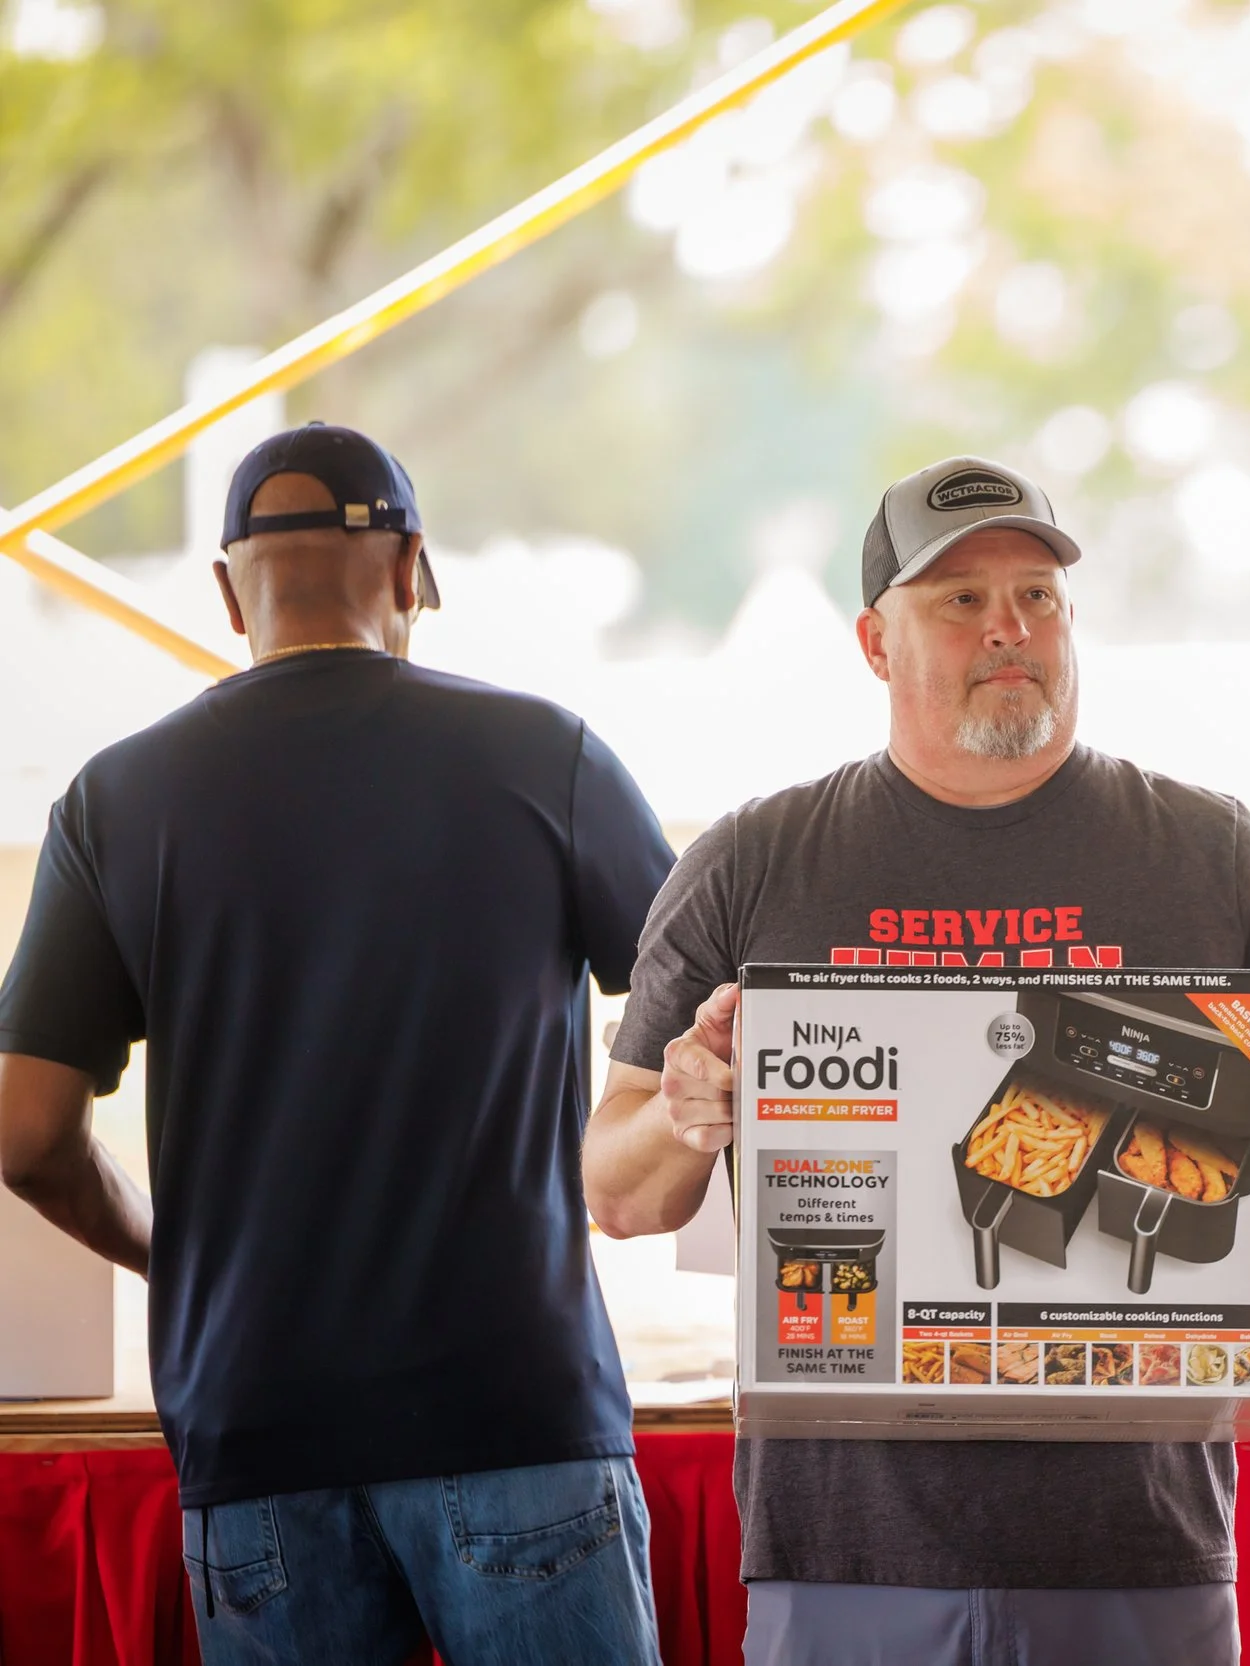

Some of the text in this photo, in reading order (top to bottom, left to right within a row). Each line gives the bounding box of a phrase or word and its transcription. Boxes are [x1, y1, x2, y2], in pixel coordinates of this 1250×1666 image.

[938, 483, 1014, 503] WCTRACTOR
[869, 906, 1082, 945] SERVICE
[788, 972, 1231, 987] The air fryer that cooks 2 foods, 2 ways, and FINISHES AT THE SAME TIME.
[1218, 1002, 1238, 1022] means
[1236, 1020, 1246, 1029] no
[1000, 1023, 1011, 1031] Up
[793, 1020, 862, 1051] NINJA
[995, 1032, 1025, 1042] 75%
[1121, 1025, 1150, 1043] NINJA
[757, 1046, 899, 1090] Foodi
[762, 1104, 893, 1116] 2-BASKET AIR FRYER
[765, 1175, 889, 1189] TECHNOLOGY
[797, 1198, 857, 1209] Different
[780, 1212, 874, 1224] temps & times
[782, 1316, 819, 1325] AIR FRY
[837, 1316, 869, 1325] ROAST
[907, 1309, 986, 1321] 8-QT capacity
[1040, 1310, 1224, 1323] 6 customizable cooking functions
[778, 1348, 875, 1359] FINISH AT THE
[787, 1362, 866, 1374] SAME TIME
